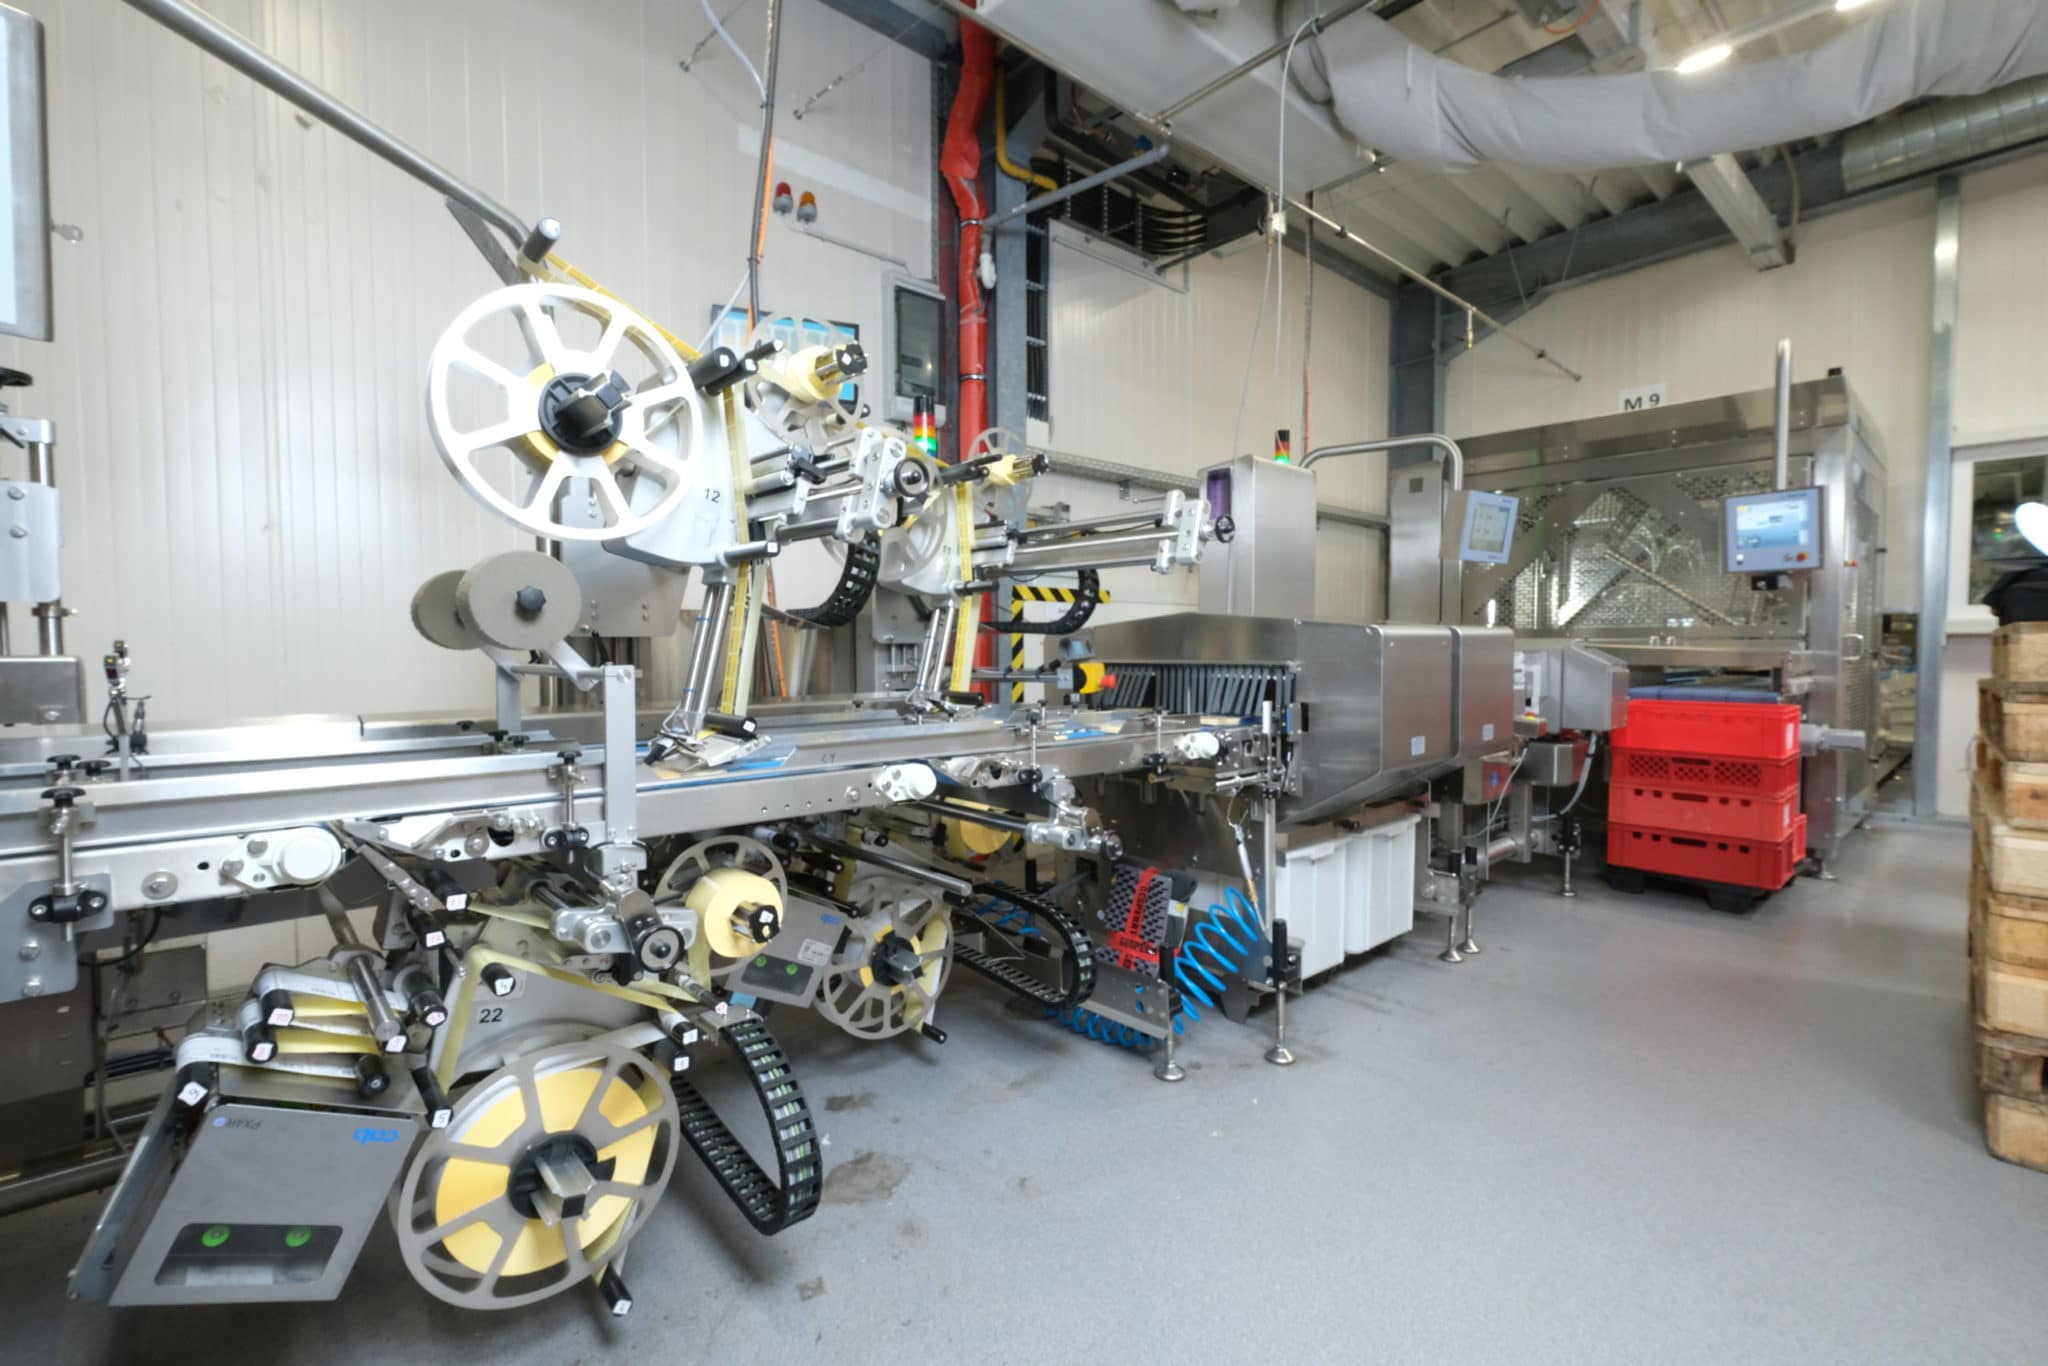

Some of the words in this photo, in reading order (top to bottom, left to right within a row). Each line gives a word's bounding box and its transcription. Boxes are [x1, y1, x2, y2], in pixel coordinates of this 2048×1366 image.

[1624, 396, 1643, 411] M
[704, 488, 721, 504] 12
[479, 1007, 503, 1024] 22
